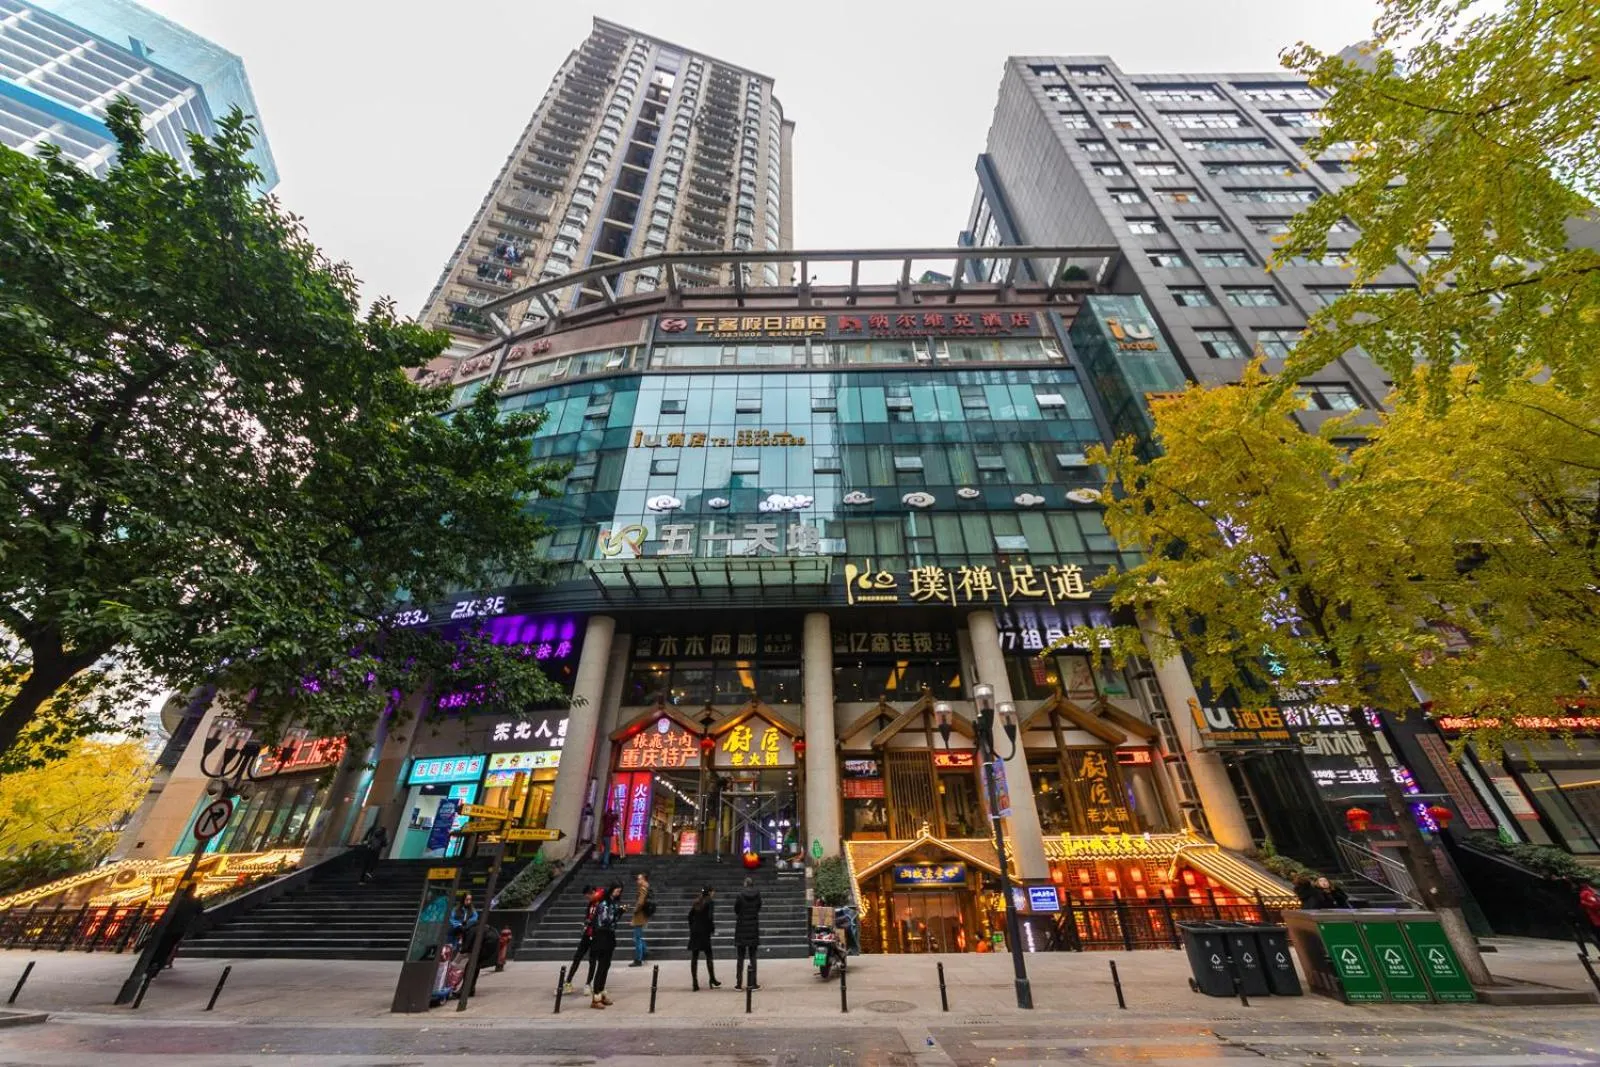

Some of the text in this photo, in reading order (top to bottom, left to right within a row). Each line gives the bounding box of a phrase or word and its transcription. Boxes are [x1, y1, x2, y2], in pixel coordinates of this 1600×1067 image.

[695, 315, 827, 332] 云客假日酒店
[868, 312, 1030, 328] 纳尔维克酒店
[657, 523, 820, 557] 五一天地
[908, 564, 1093, 602] 璞禅足道
[1232, 706, 1285, 729] 酒店
[619, 747, 699, 768] 重庆特产
[628, 783, 648, 842] 火锅底料
